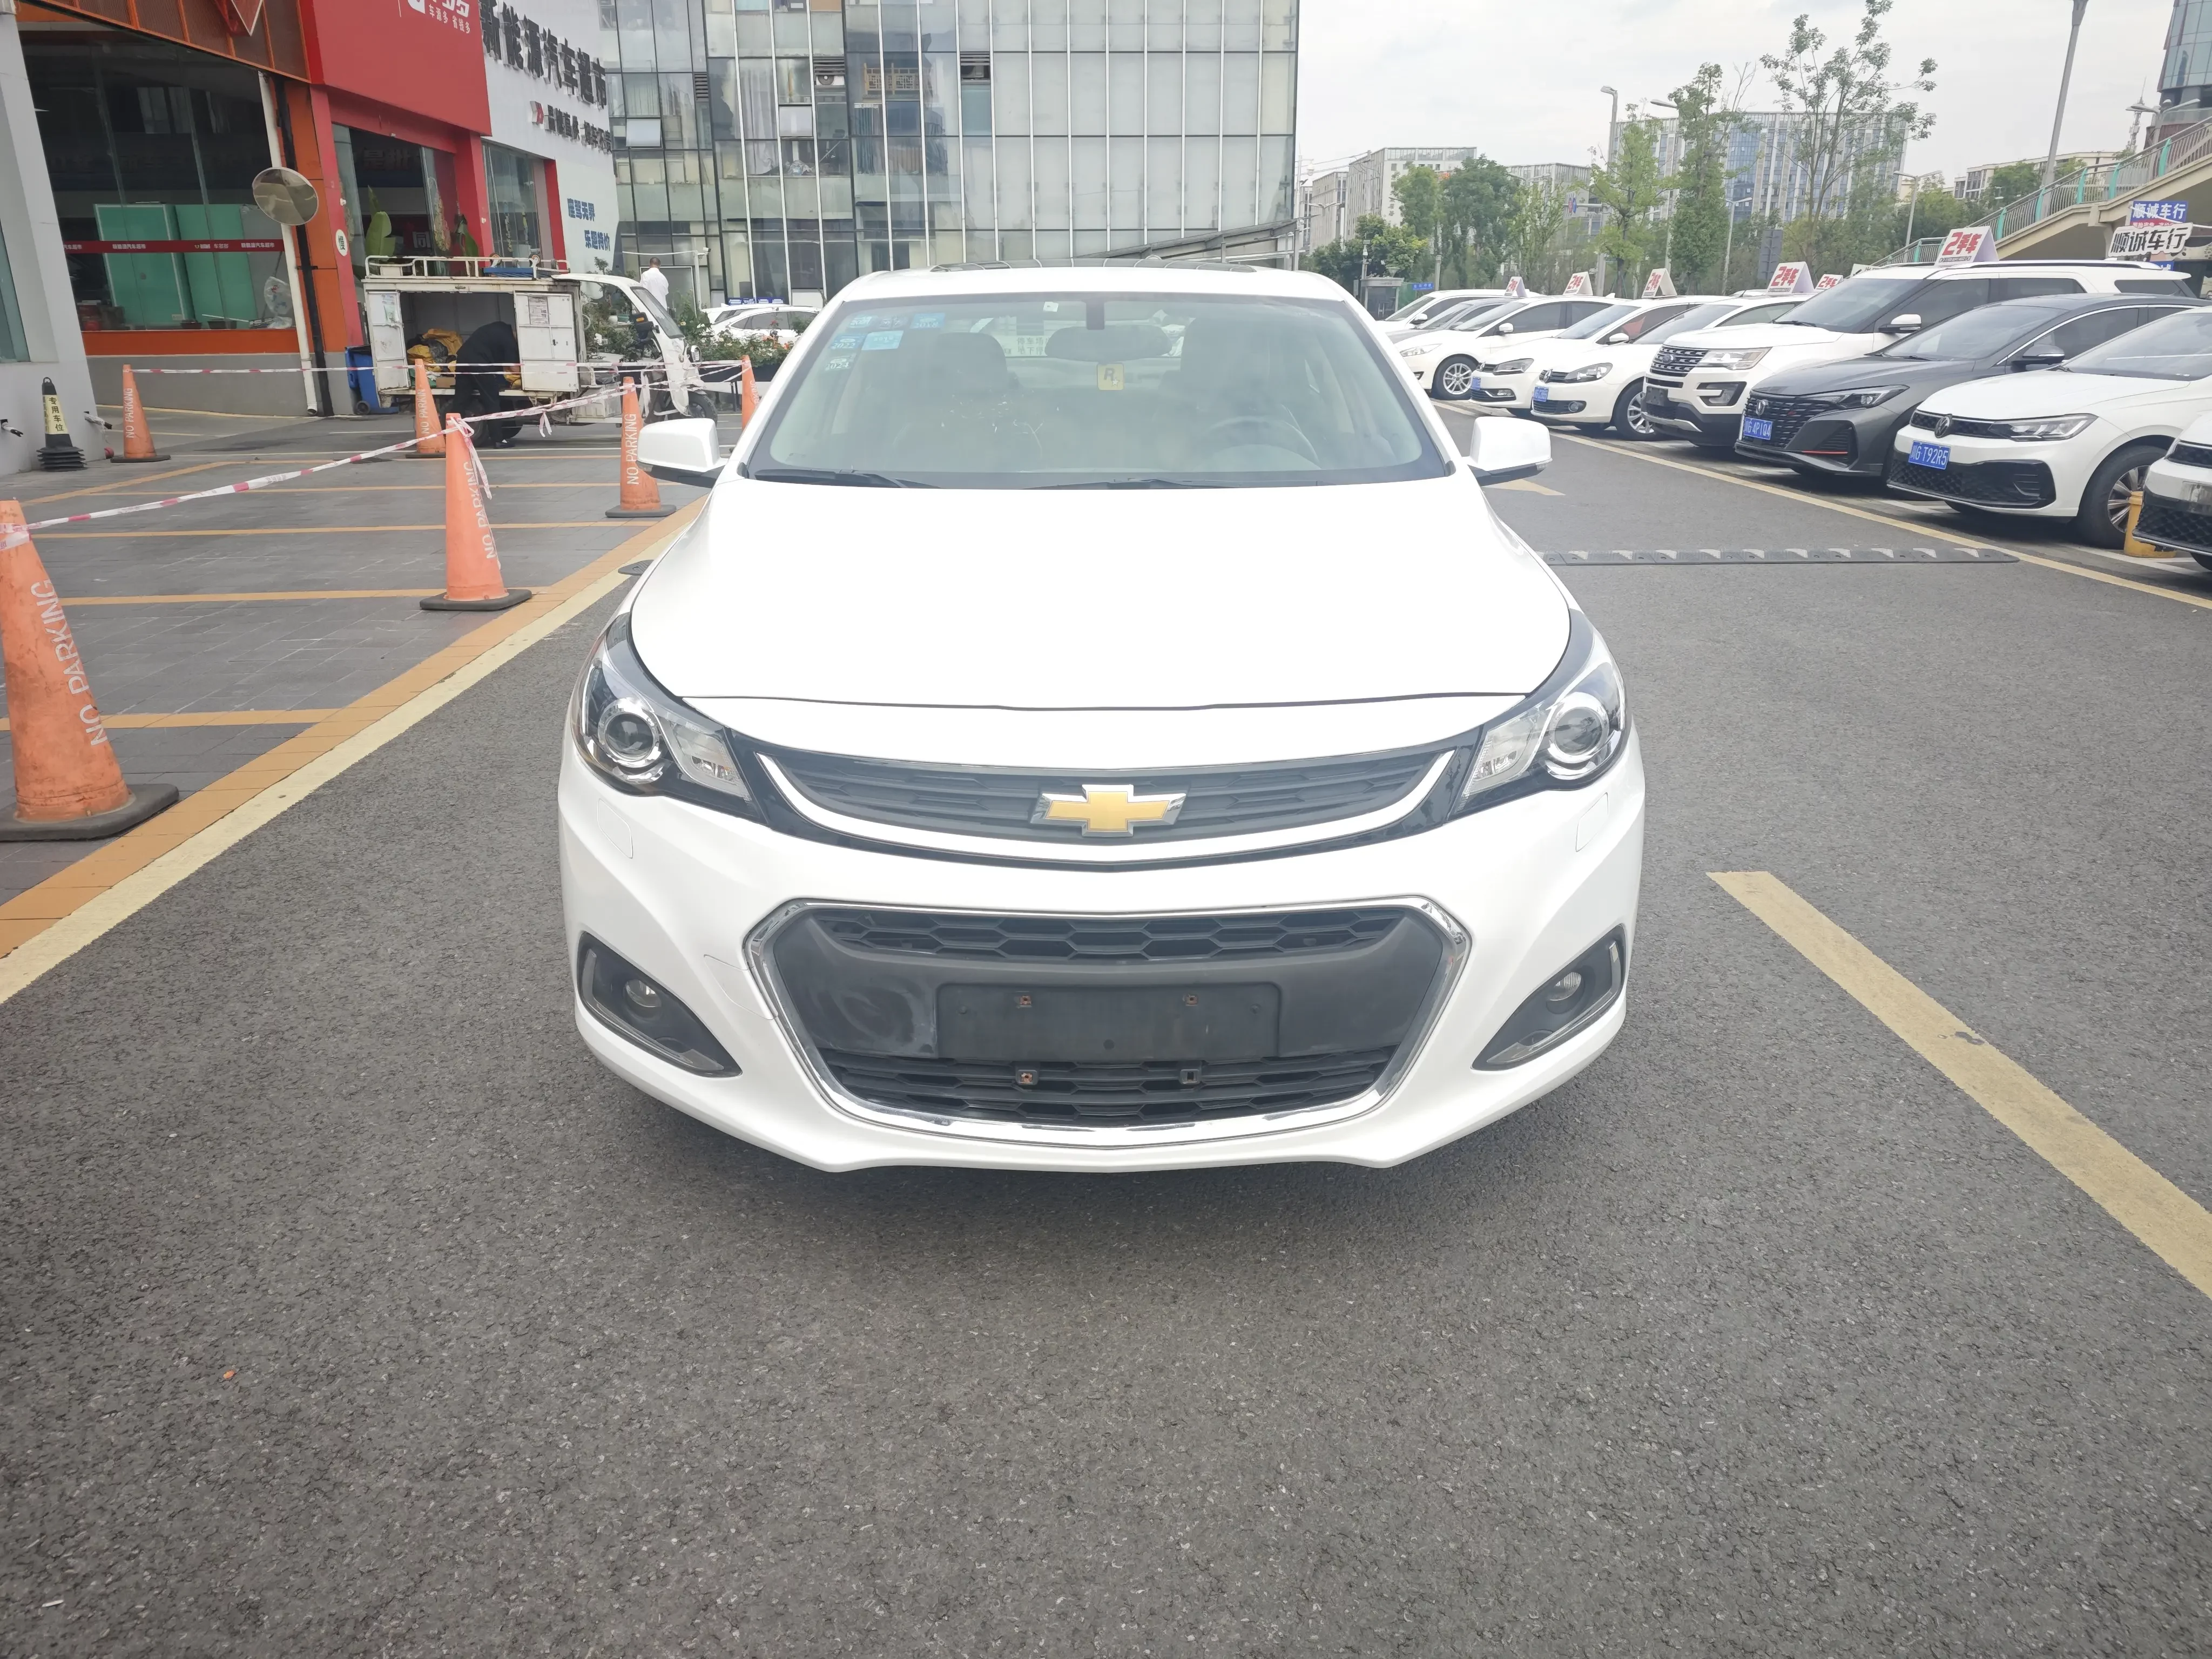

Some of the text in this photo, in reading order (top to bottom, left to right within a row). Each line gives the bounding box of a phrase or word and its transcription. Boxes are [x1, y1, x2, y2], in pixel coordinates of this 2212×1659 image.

[428, 3, 448, 23] 车源多
[480, 0, 607, 110] 新能源汽车超市
[2133, 203, 2186, 219] 顺诚车行
[1941, 232, 1982, 255] 2手车
[2110, 227, 2188, 253] 顺诚车行
[1771, 266, 1799, 286] 2手车
[49, 397, 64, 431] 专用车位
[123, 388, 135, 439] NO PARKING
[420, 421, 430, 434] NO
[624, 414, 639, 485] NO PARKING
[482, 535, 496, 559] NO
[30, 578, 108, 746] NO PARKING
